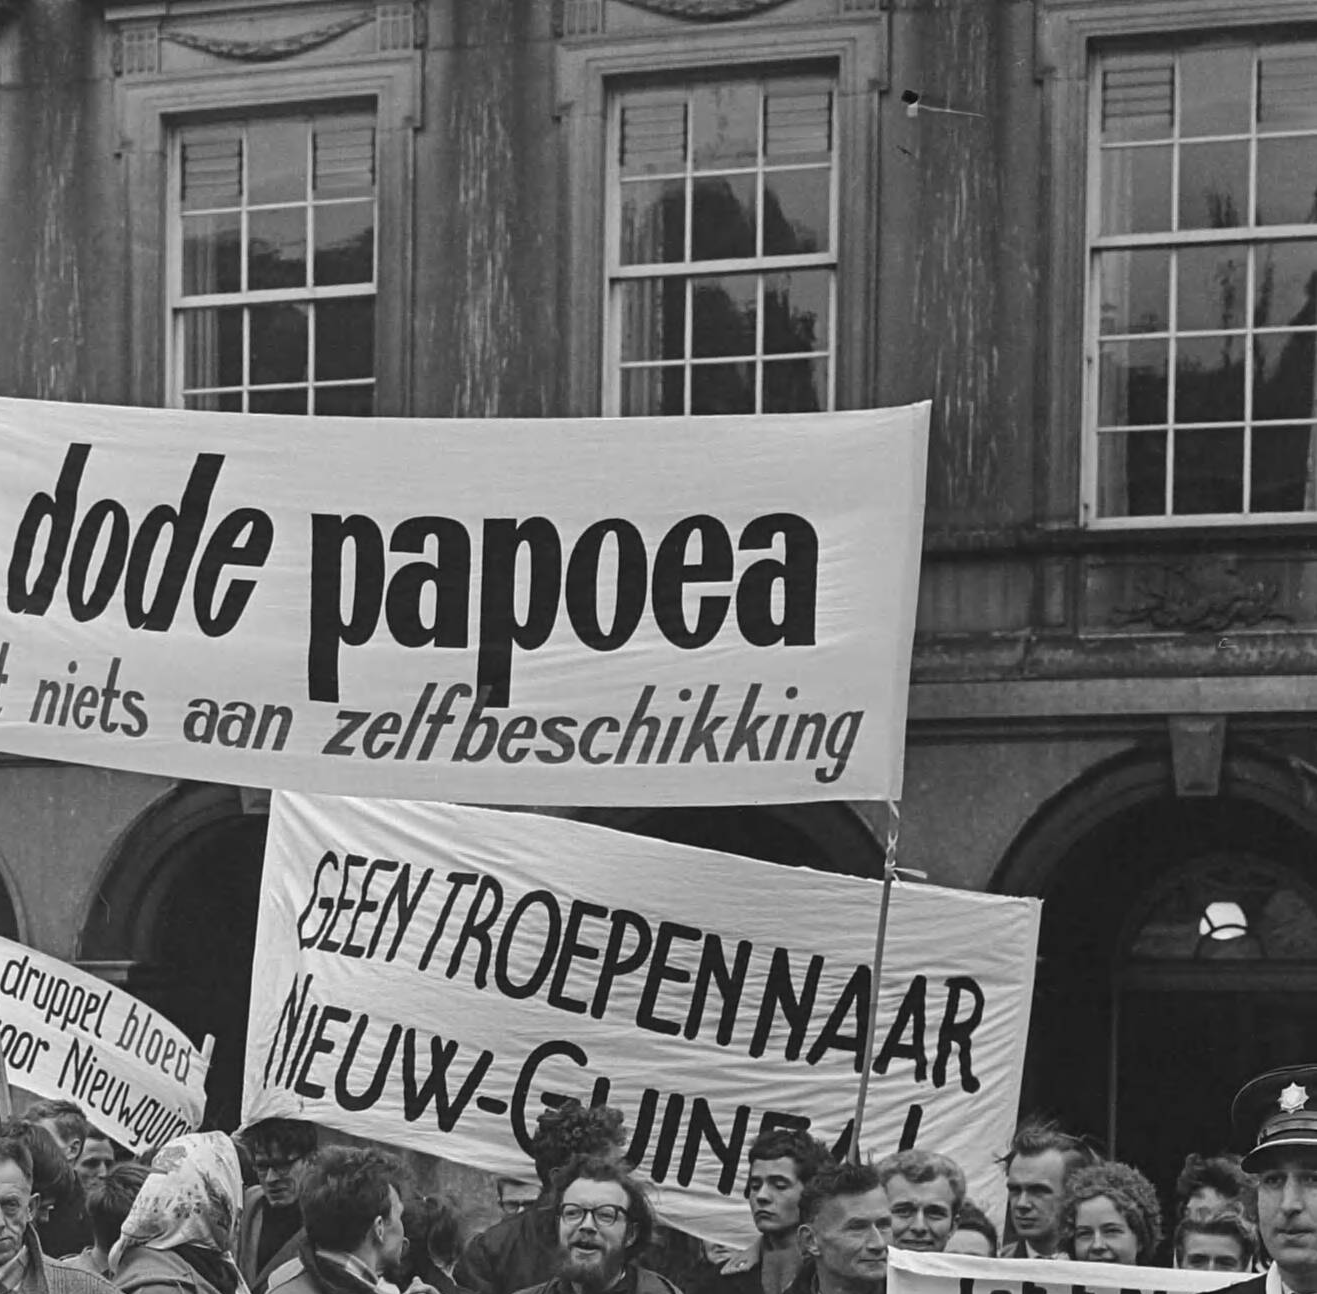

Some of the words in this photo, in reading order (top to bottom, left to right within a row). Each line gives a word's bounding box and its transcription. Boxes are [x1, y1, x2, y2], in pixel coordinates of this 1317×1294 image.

[7, 442, 275, 638] dode
[308, 512, 819, 709] papoea
[29, 657, 149, 738] niets
[183, 698, 293, 752] aan
[321, 682, 865, 784] zelfbeschikking
[0, 955, 112, 1039] druppel
[115, 1002, 192, 1086] bloed
[297, 850, 434, 963] GEEN
[418, 872, 753, 1047] TROEPEN
[749, 947, 985, 1094] NAAR
